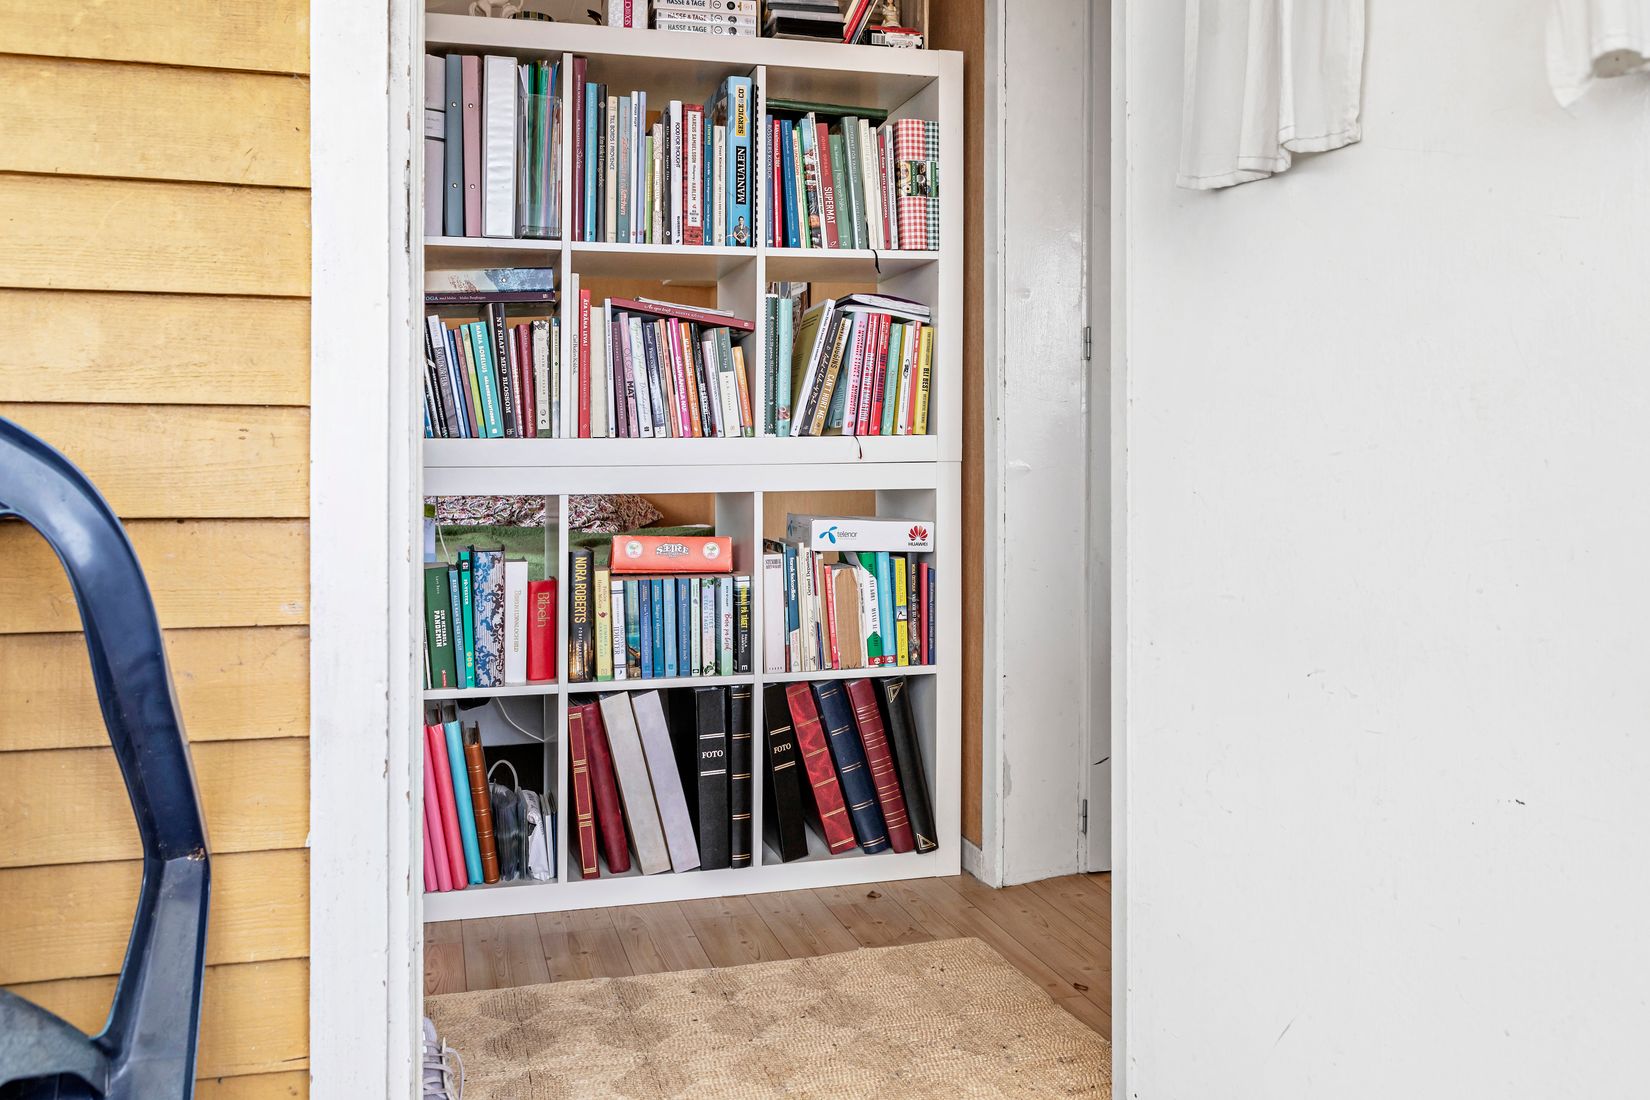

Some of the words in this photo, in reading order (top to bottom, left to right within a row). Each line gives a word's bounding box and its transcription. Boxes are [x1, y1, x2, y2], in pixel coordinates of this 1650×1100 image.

[692, 25, 707, 33] TAGE
[737, 147, 746, 203] MANUALEN
[824, 186, 835, 224] SUPERMAT
[496, 317, 502, 327] NY
[632, 322, 641, 348] Agneta
[497, 330, 505, 355] KRAFT
[831, 342, 843, 369] GOGGINS
[434, 348, 447, 387] SKÖLDKÖRTELN
[478, 346, 487, 373] BORELIUS
[624, 348, 632, 380] OLGAS
[626, 381, 634, 399] MAT
[825, 374, 835, 391] CAN'T
[876, 353, 887, 402] INFLAMMATION
[921, 378, 929, 392] BEST
[502, 377, 511, 413] BLOSSOM
[821, 392, 831, 408] HURT
[860, 374, 872, 422] INFLAMMATION
[817, 410, 826, 419] ME
[837, 530, 857, 538] telenor
[574, 556, 587, 582] NORA
[537, 592, 550, 627] Bibeln
[574, 583, 587, 623] ROBERTS
[434, 610, 442, 648] PANDEMIN
[740, 614, 749, 629] TÅGET
[702, 749, 723, 759] FOTO
[773, 742, 791, 754] FOTO
